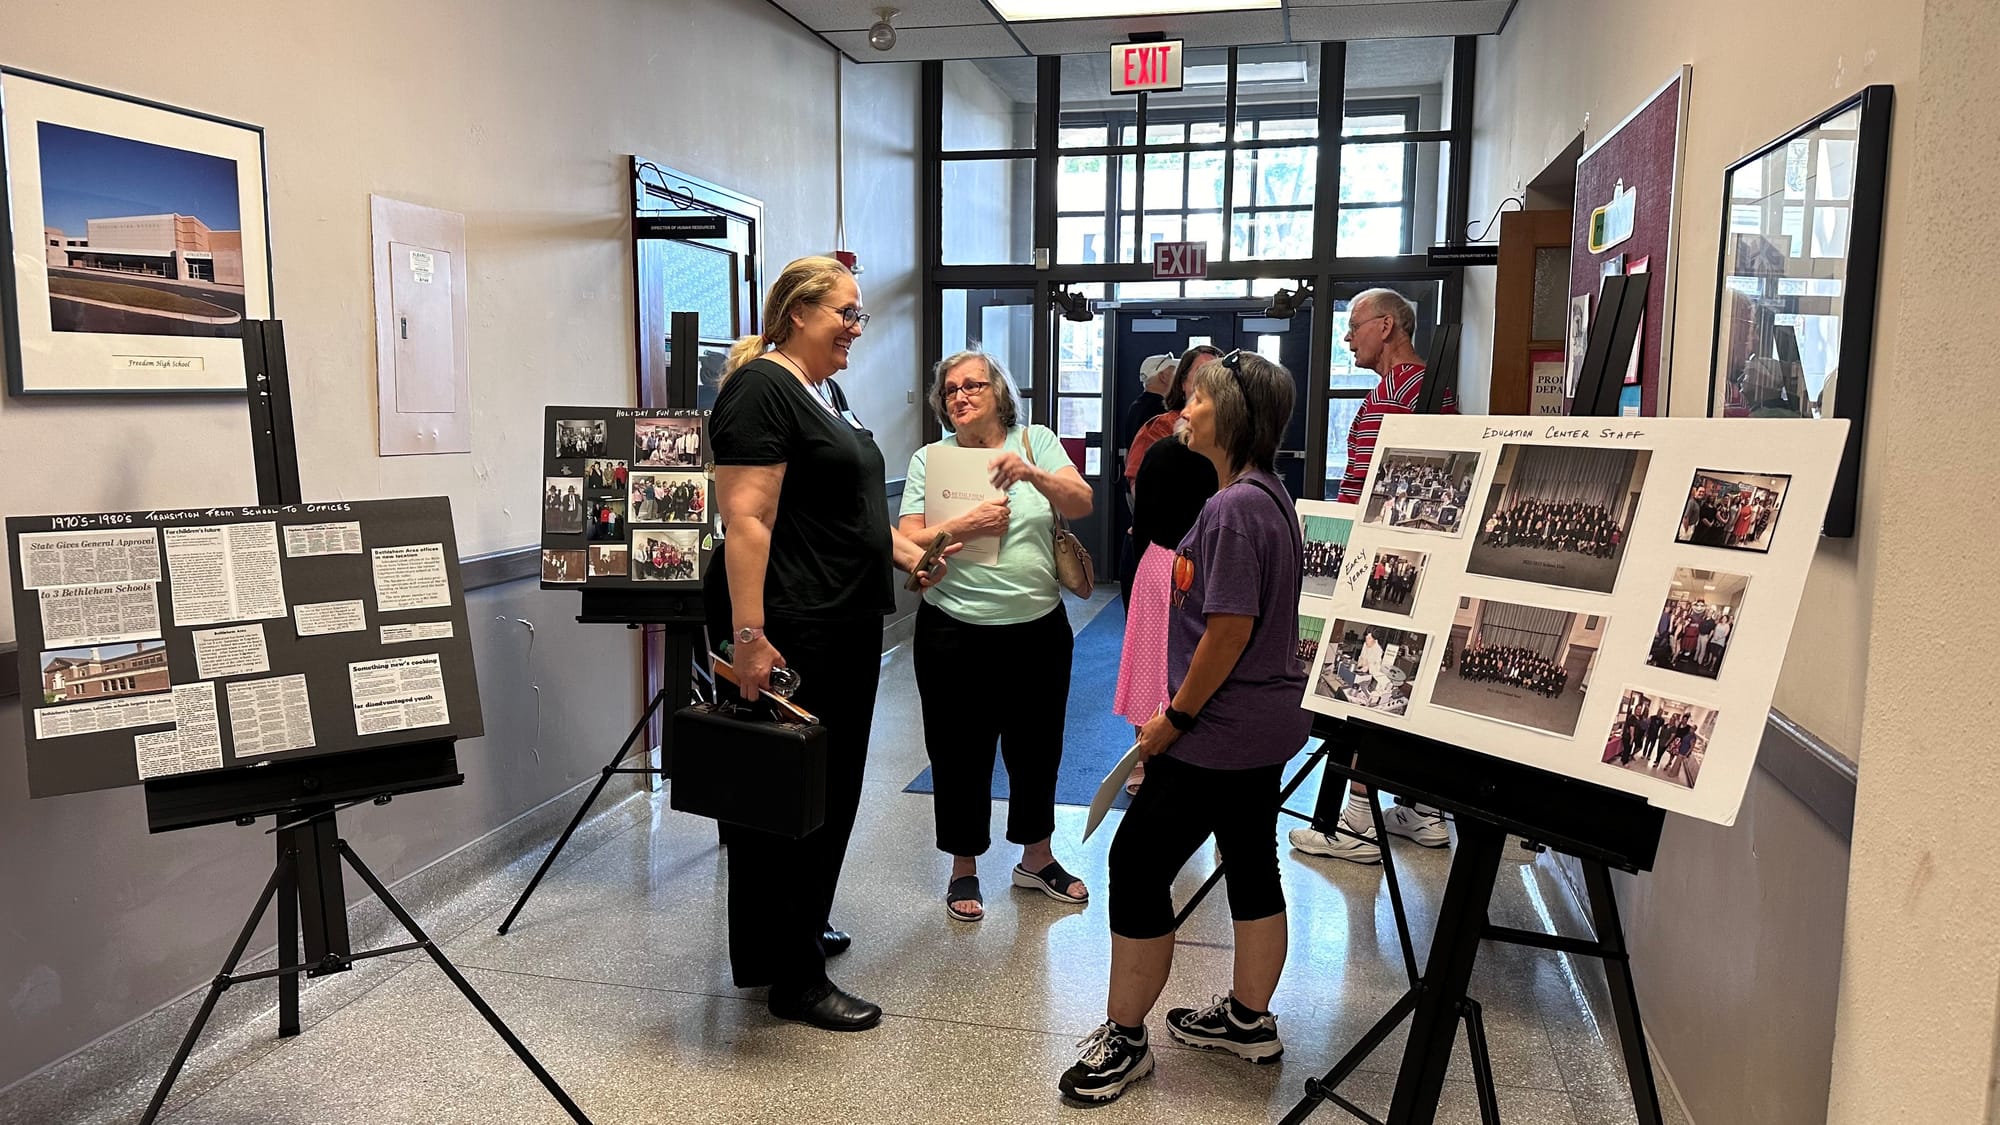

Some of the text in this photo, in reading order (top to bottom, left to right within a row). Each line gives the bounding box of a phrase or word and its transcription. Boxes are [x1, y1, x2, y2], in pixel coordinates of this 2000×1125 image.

[1124, 46, 1171, 86] EXIT
[1156, 244, 1206, 275] EXIT
[156, 360, 171, 368] High
[616, 409, 648, 418] HOLIDAY
[1482, 425, 1645, 439] EDUCATION CENTER STAFF
[145, 510, 200, 521] TRANSITION
[205, 508, 234, 517] FROM
[241, 507, 279, 516] SCHOOL
[281, 505, 297, 513] TO
[306, 503, 351, 512] OFFICES
[30, 537, 154, 550] State Gives General Approval
[41, 583, 151, 599] to 3 Bethlehem Schools
[352, 664, 389, 672] Something
[365, 697, 413, 708] disadvantaged
[414, 694, 433, 702] youth
